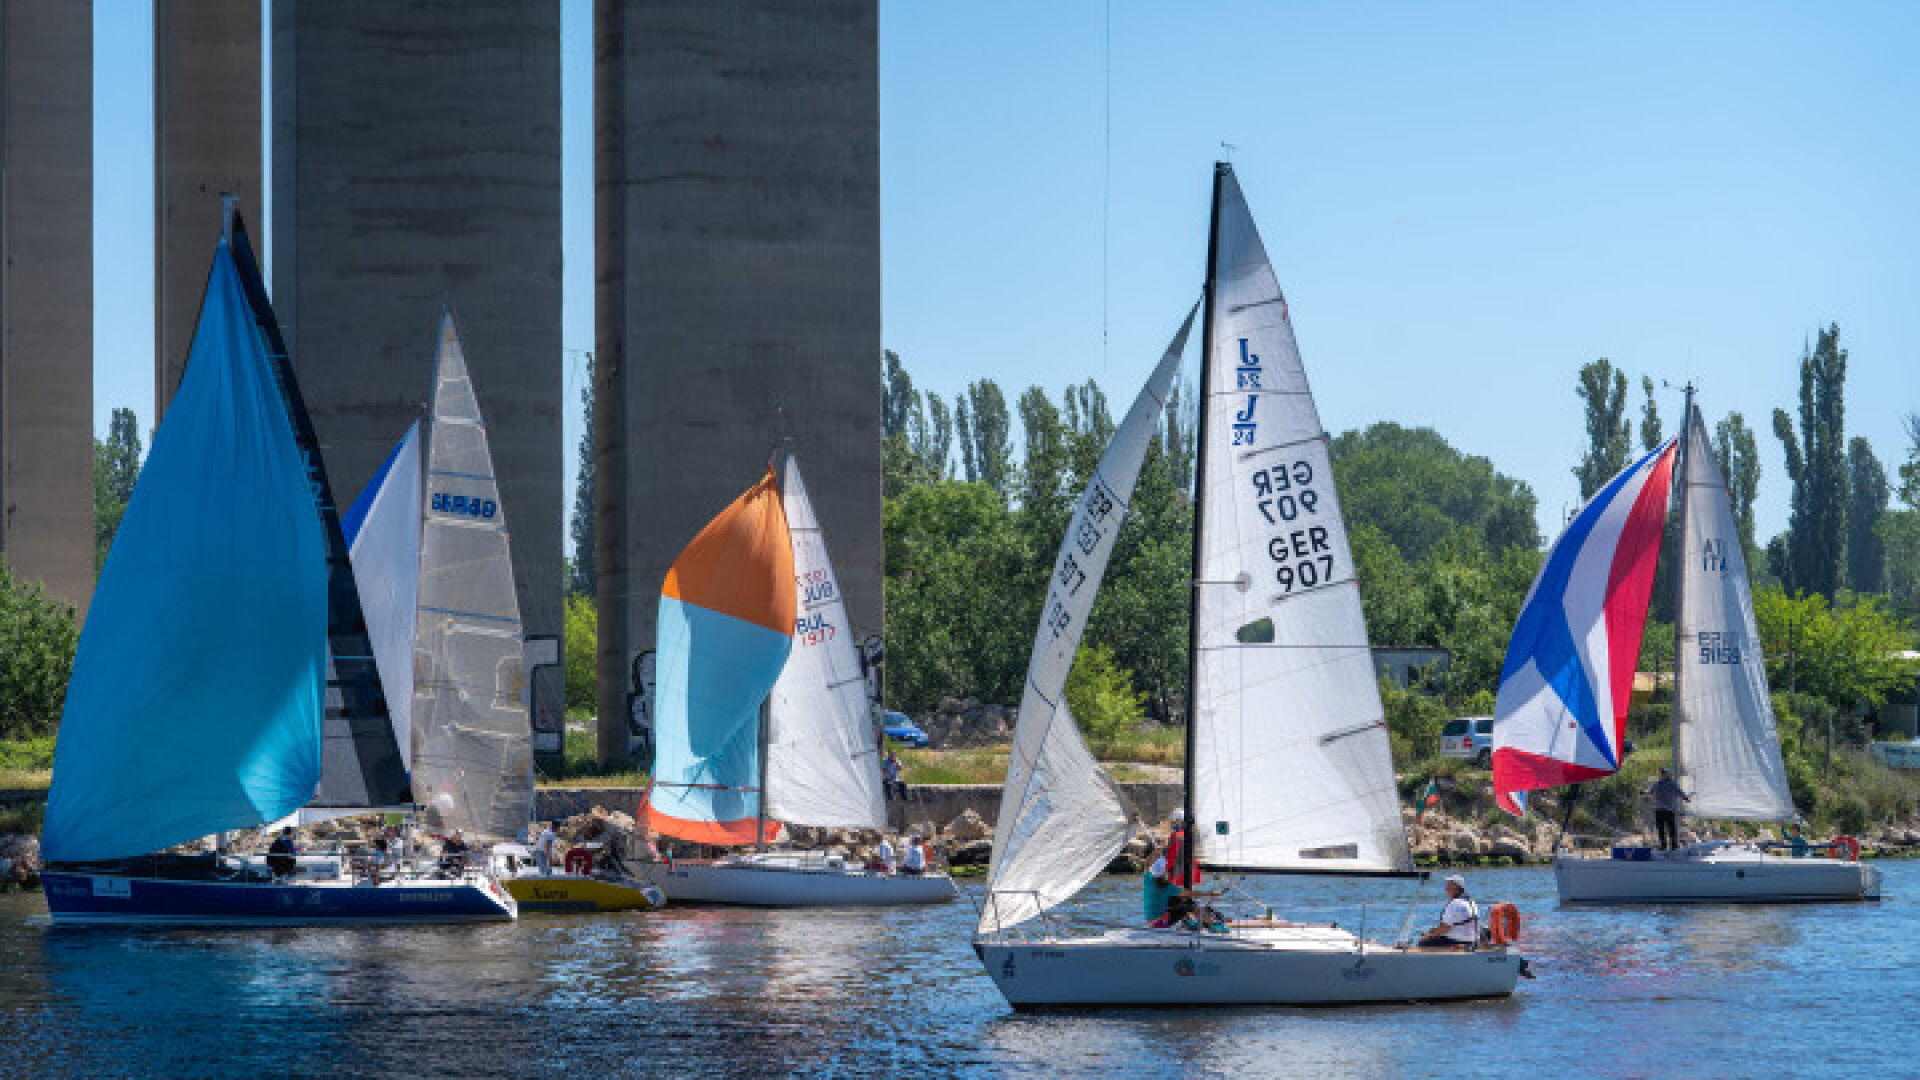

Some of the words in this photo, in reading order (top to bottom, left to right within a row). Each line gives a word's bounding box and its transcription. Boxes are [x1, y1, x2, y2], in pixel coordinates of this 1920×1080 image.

[1236, 394, 1259, 422] J
[1268, 525, 1331, 563] GER
[1276, 554, 1334, 593] 907
[796, 613, 831, 634] BUL
